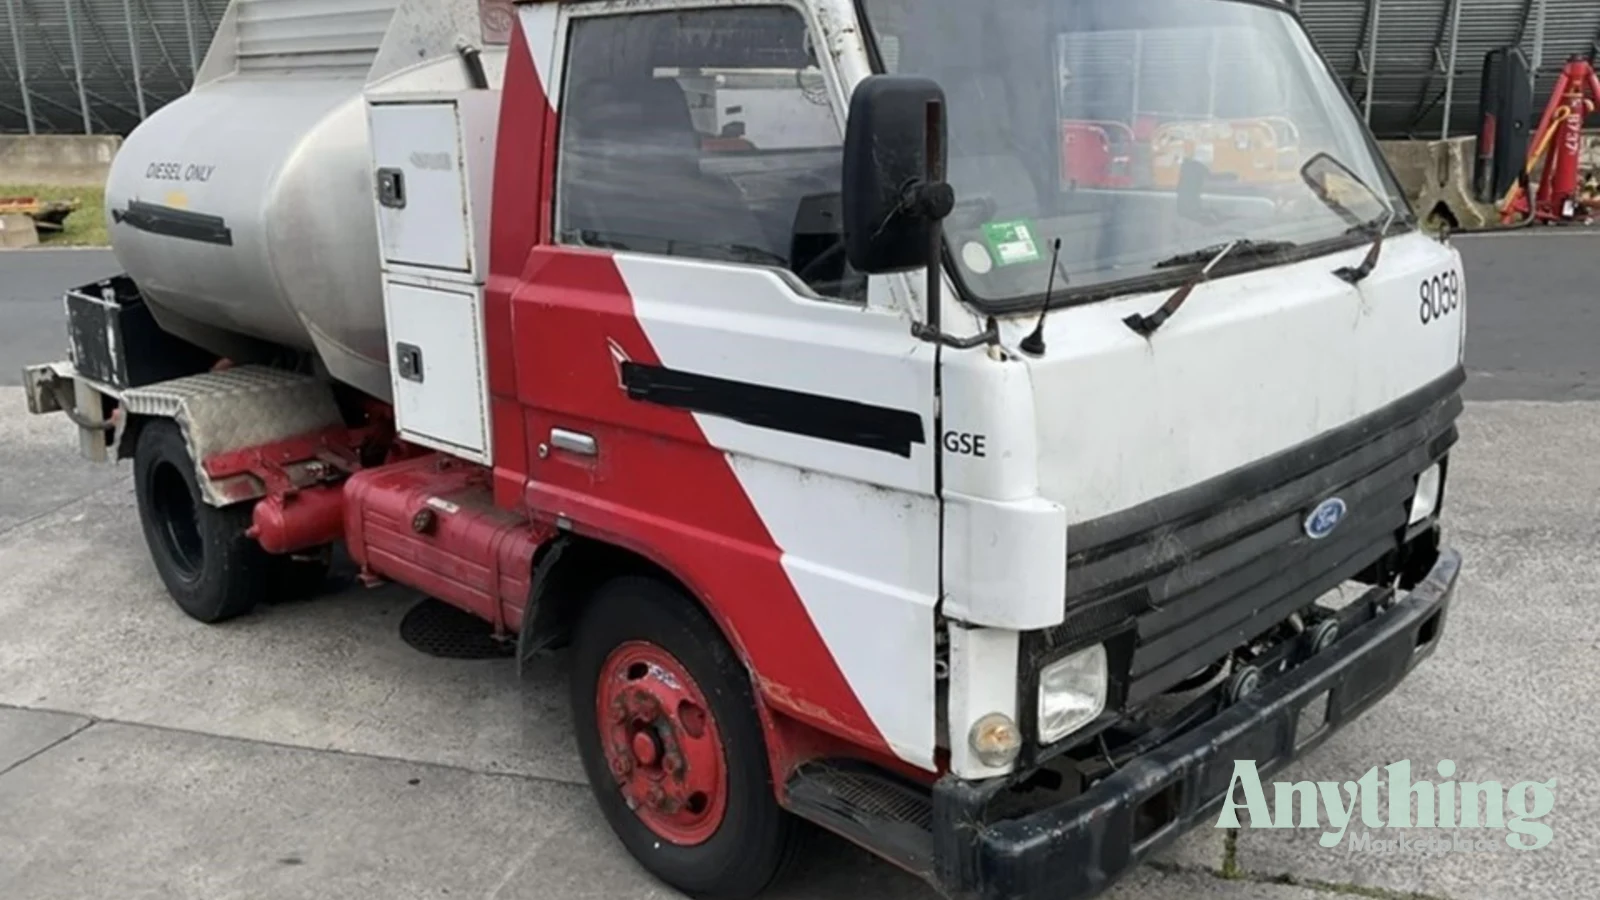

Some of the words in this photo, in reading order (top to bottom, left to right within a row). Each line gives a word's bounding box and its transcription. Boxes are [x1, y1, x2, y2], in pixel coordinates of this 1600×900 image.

[146, 162, 181, 180] DIESEL
[184, 164, 216, 182] ONLY
[1420, 270, 1458, 325] 8059
[943, 431, 986, 457] GSE
